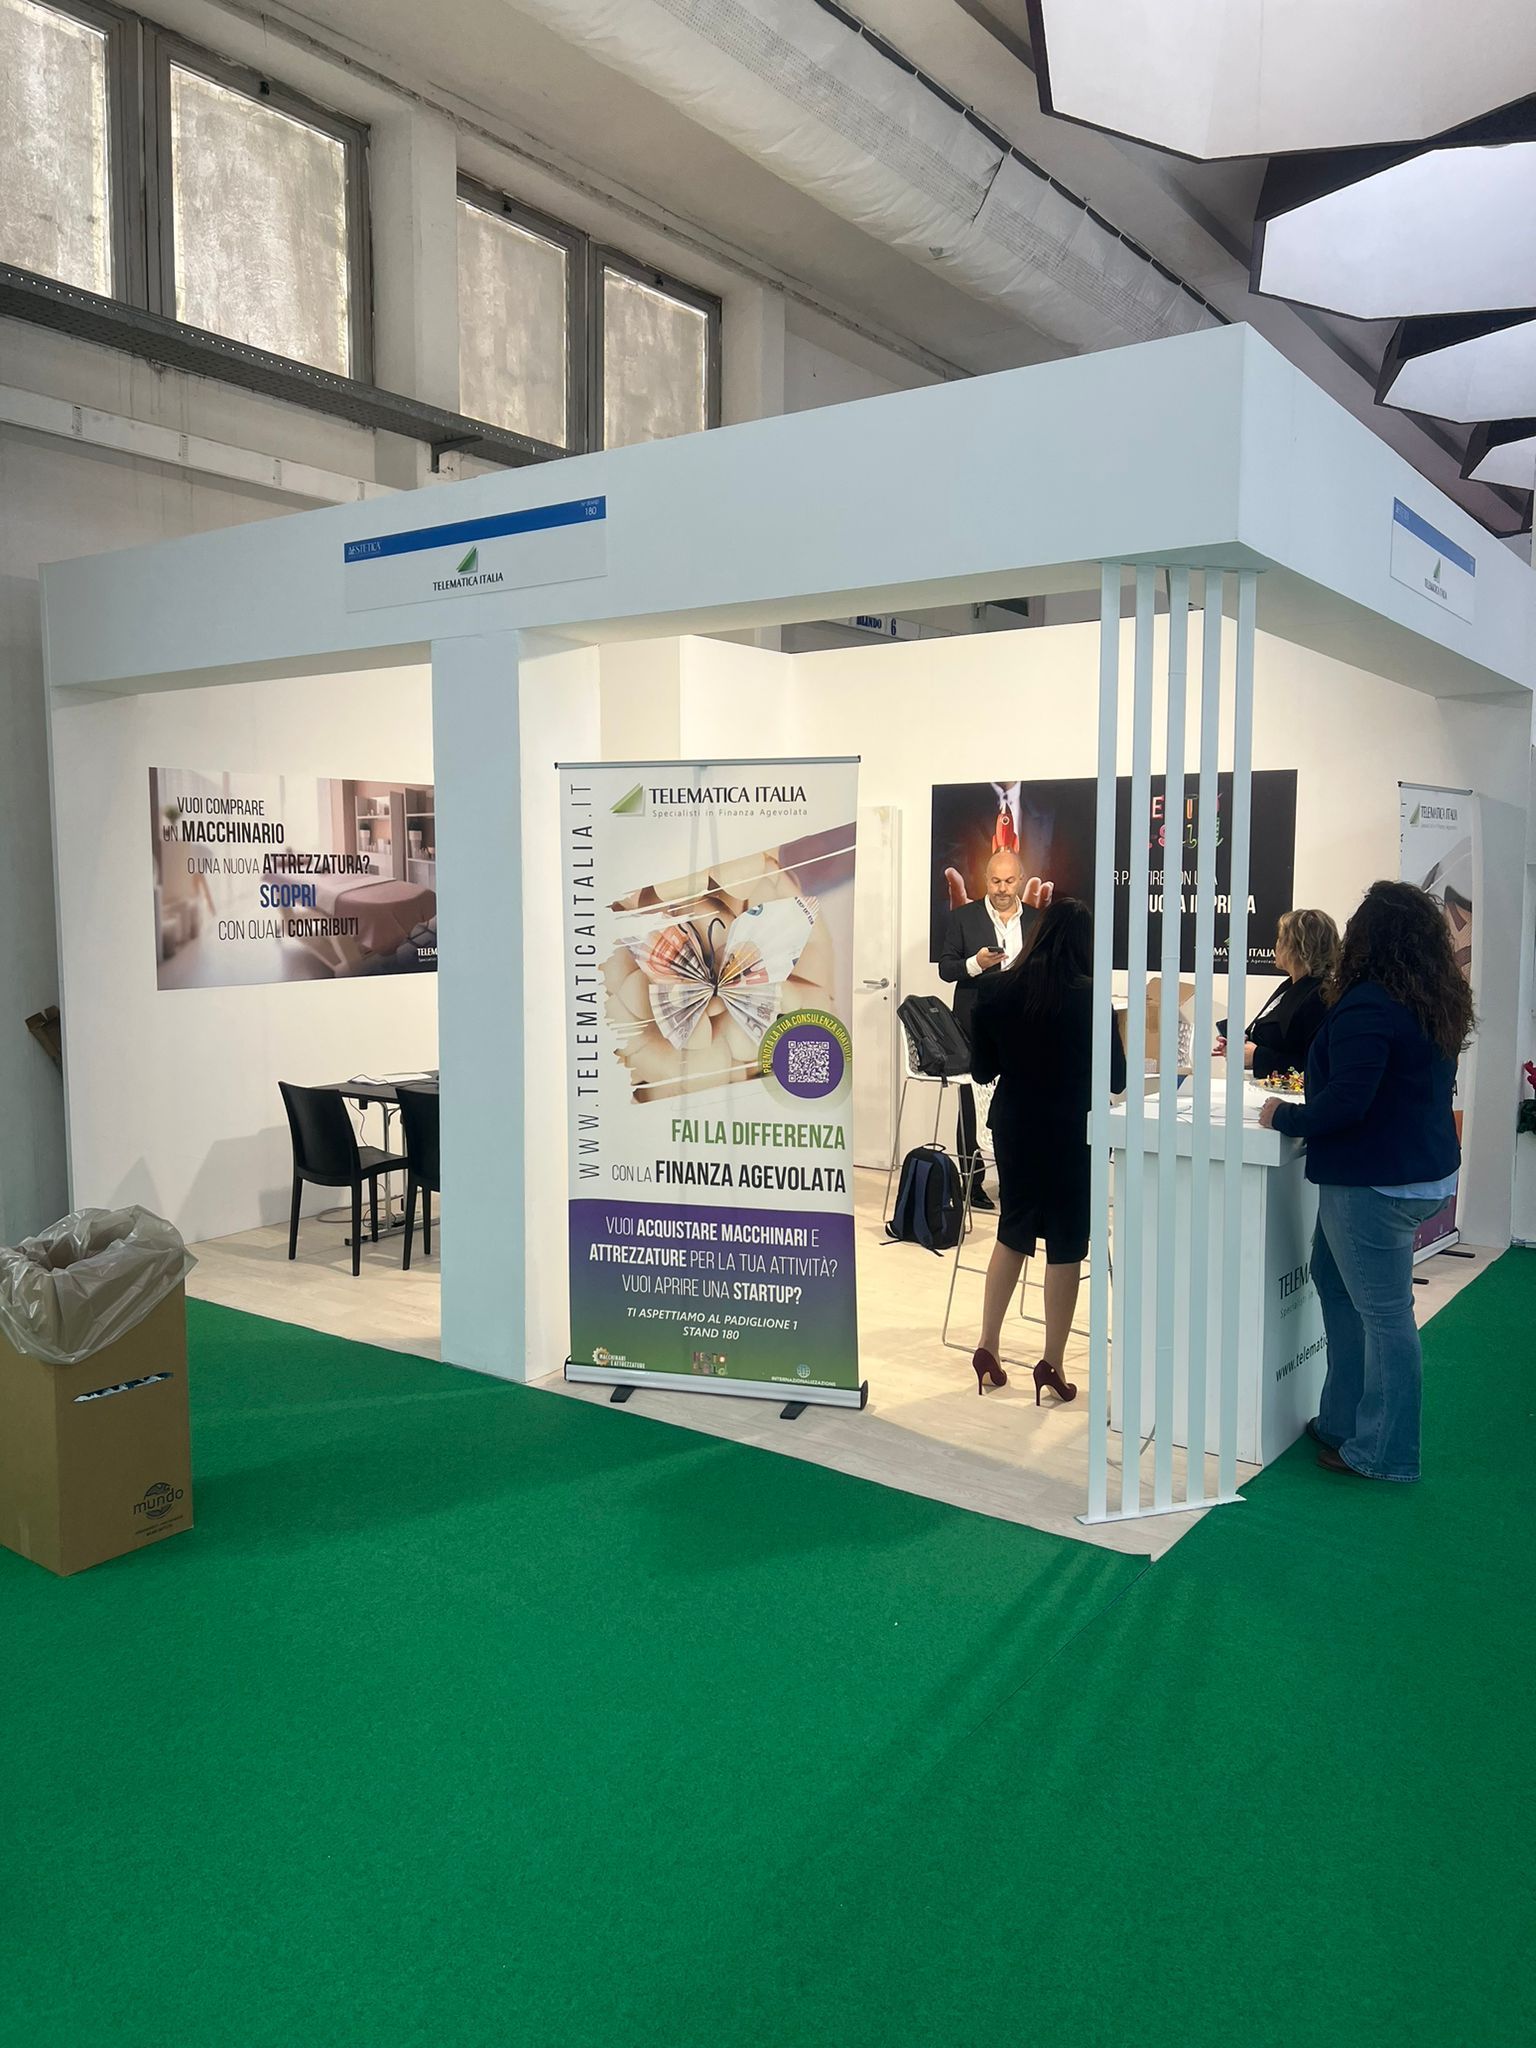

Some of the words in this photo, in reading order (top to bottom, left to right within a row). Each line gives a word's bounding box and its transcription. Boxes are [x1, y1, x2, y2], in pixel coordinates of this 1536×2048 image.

[584, 506, 597, 516] 180
[432, 575, 479, 592] TELEMATICA
[479, 572, 504, 585] ITALIA
[890, 617, 897, 636] 6
[177, 796, 203, 814] VUOI
[205, 798, 265, 816] COMPRARE
[649, 787, 750, 804] TELEMATICA
[755, 786, 807, 803] ITALIA
[652, 808, 701, 818] Specialisti
[706, 808, 714, 817] in
[718, 808, 755, 817] Finanza
[759, 808, 808, 818] Agevolata
[163, 825, 179, 842] UN
[182, 820, 285, 844] MACCHINARIO
[187, 857, 195, 874] O
[197, 857, 221, 874] UNA
[223, 857, 260, 874] NUOVA
[262, 853, 370, 875] ATTREZZATURA?
[260, 884, 316, 908] SCOPRI
[218, 919, 245, 940] CON
[248, 919, 285, 940] QUALI
[288, 917, 359, 938] CONTRIBUTI
[1248, 948, 1276, 958] ITALIA
[570, 784, 600, 1180] WWW.TELEMATICAITALIA.IT
[762, 1040, 774, 1074] PRENOTA
[770, 1030, 781, 1041] LA
[776, 1020, 793, 1033] TUA
[791, 1013, 838, 1033] CONSULENZA
[671, 1119, 699, 1143] FAI
[704, 1120, 727, 1145] LA
[732, 1121, 846, 1150] DIFFERENZA
[611, 1164, 634, 1182] CON
[636, 1166, 652, 1183] LA
[655, 1159, 734, 1187] FINANZA
[738, 1164, 846, 1193] AGEVOLATA
[605, 1216, 634, 1235] VUOI
[636, 1219, 718, 1241] ACQUISTARE
[721, 1223, 808, 1247] MACCHINARI
[811, 1229, 820, 1247] E
[589, 1243, 687, 1268] ATTREZZATURE
[690, 1250, 715, 1269] PER
[717, 1252, 736, 1271] LA
[739, 1253, 765, 1273] TUA
[769, 1255, 838, 1278] ATTIVITÀ?
[622, 1274, 651, 1293] VUOI
[654, 1277, 700, 1297] APRIRE
[702, 1280, 730, 1299] UNA
[733, 1282, 802, 1305] STARTUP?
[1278, 1263, 1312, 1300] TELEM
[627, 1307, 638, 1318] TI
[638, 1308, 706, 1323] ASPETTIAMO
[707, 1313, 721, 1324] AL
[724, 1314, 790, 1330] PADIGLIONE
[792, 1320, 798, 1331] 1
[682, 1326, 720, 1339] STAND
[721, 1329, 740, 1341] 180
[133, 1488, 184, 1516] mundo
